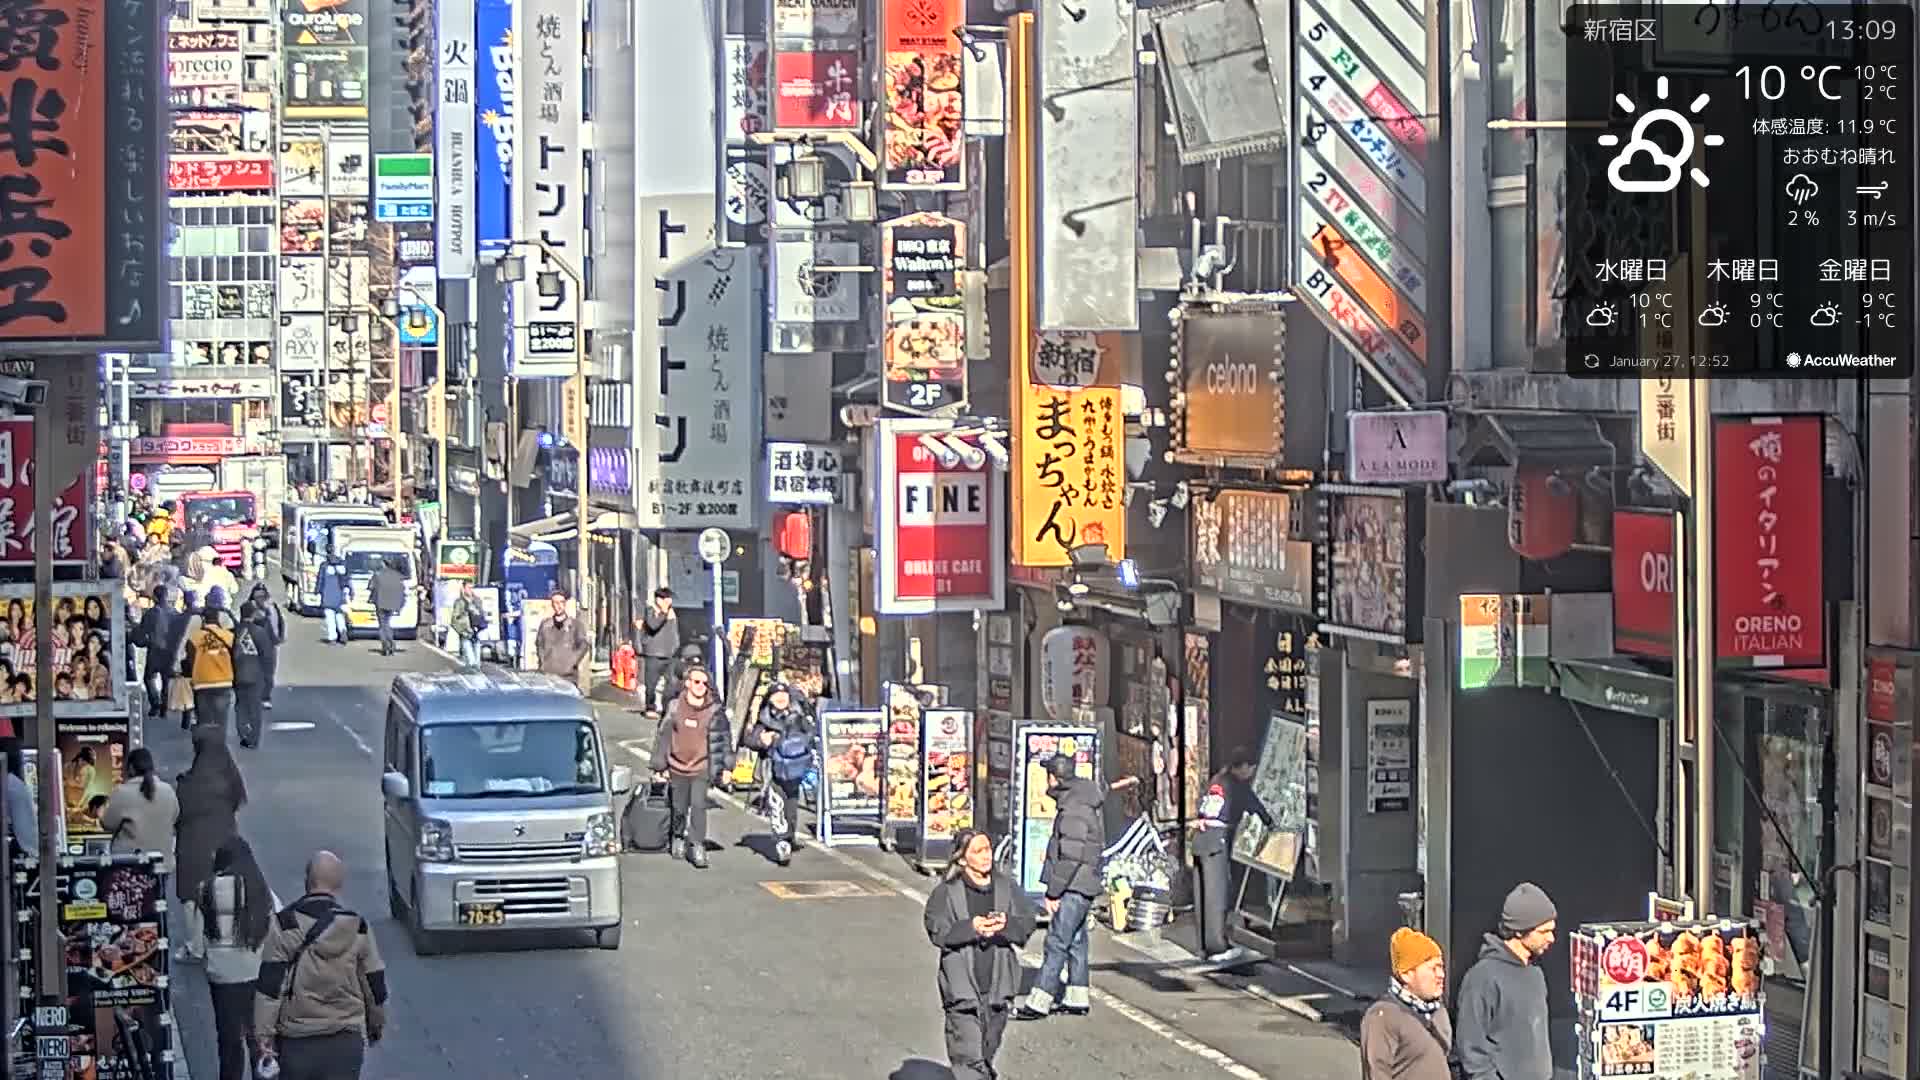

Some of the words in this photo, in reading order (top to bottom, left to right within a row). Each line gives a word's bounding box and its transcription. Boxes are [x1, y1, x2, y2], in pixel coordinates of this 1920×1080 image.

[1308, 22, 1328, 41] 5
[1309, 75, 1327, 91] 4
[381, 181, 429, 192] FamilyMart
[1308, 172, 1328, 193] 2
[450, 205, 463, 255] HOTPOT
[894, 255, 953, 273] Walton's
[1307, 269, 1334, 298] B1
[655, 210, 687, 462] トントン
[1038, 337, 1097, 374] 新宿
[1207, 353, 1257, 395] celona
[911, 384, 942, 405] 2F
[774, 451, 837, 471] 酒場心
[1397, 458, 1439, 471] MODE
[1036, 396, 1080, 548] まっちゃん
[774, 475, 836, 492] 新宿本店
[906, 485, 980, 513] FINE
[1750, 431, 1782, 604] 俺のイタリアン
[904, 560, 948, 576] ONLINE
[952, 560, 982, 575] CAFE
[1735, 616, 1802, 633] ORENO
[1735, 634, 1802, 650] ITALIAN
[1606, 990, 1640, 1012] 4F
[35, 1006, 67, 1027] NERO
[38, 1037, 69, 1058] NERO
